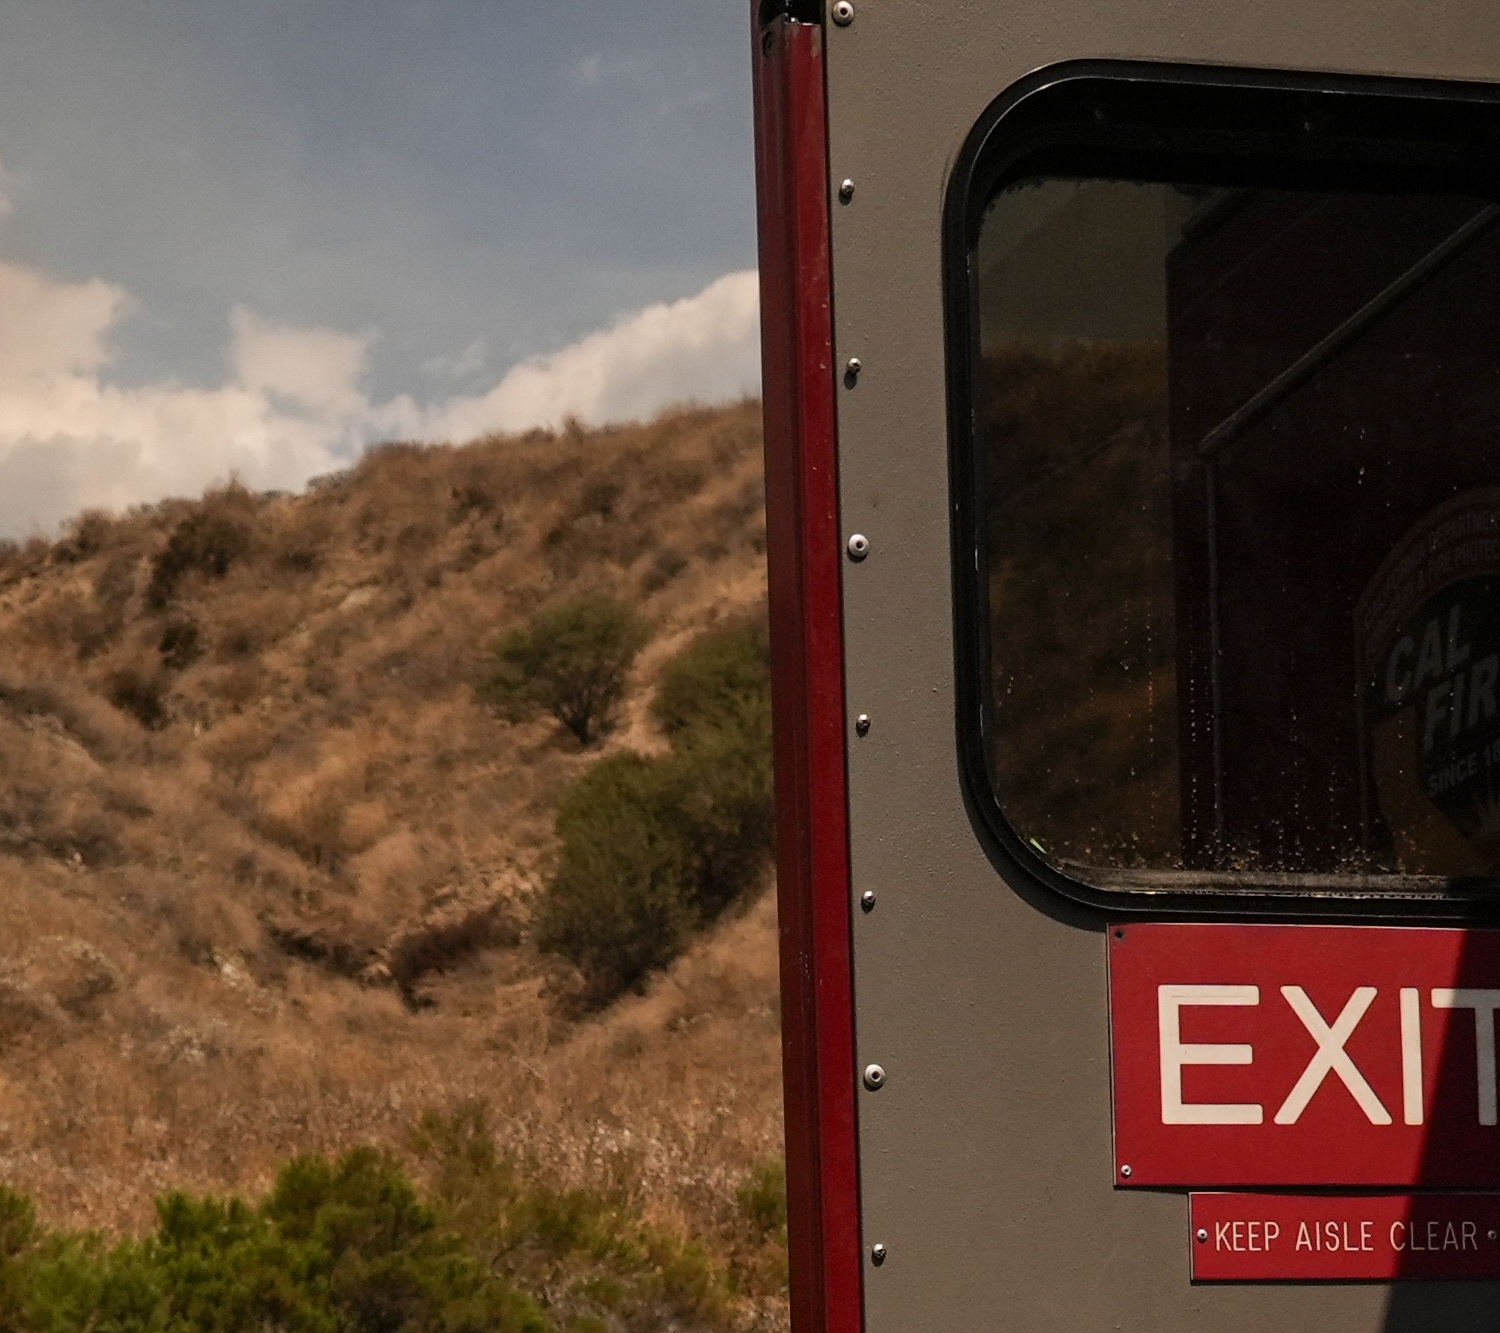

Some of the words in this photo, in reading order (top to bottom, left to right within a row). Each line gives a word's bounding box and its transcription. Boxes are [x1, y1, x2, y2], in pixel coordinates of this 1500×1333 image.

[1386, 603, 1471, 702] CAL
[1427, 751, 1478, 798] SINCE
[1214, 1221, 1281, 1253] KEEP
[1295, 1221, 1375, 1253] AISLE
[1389, 1221, 1479, 1253] CLEAR
